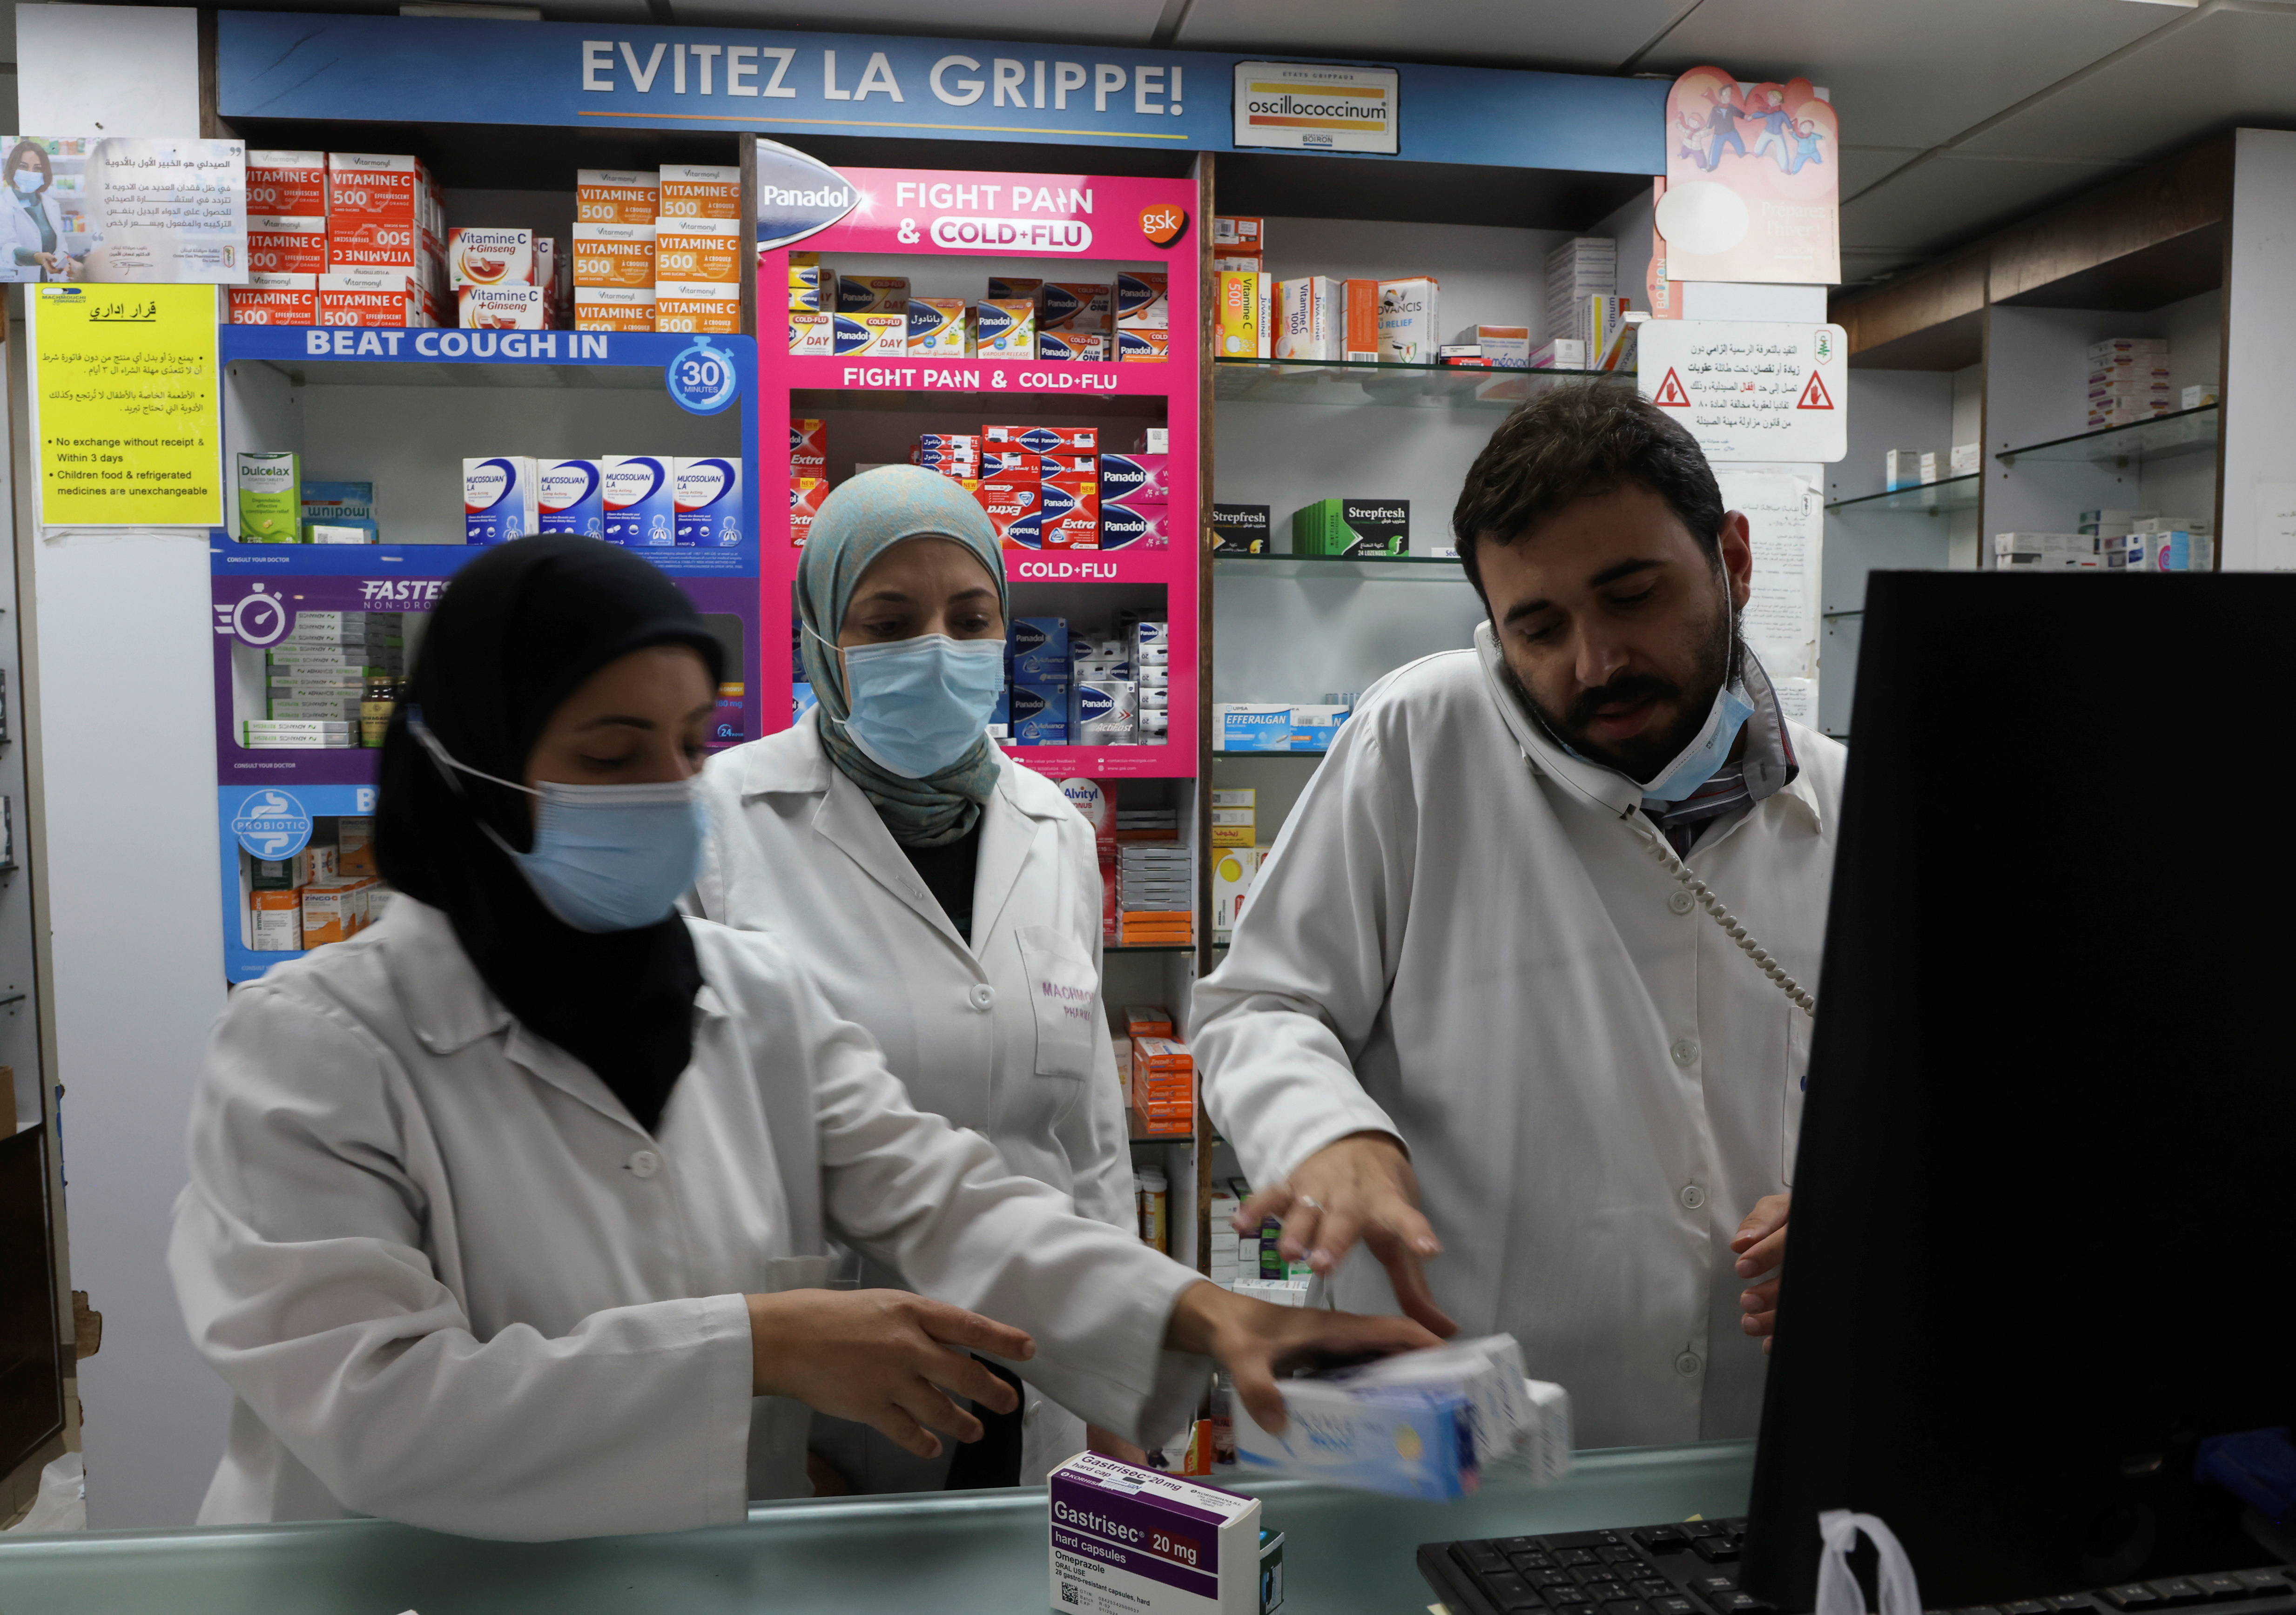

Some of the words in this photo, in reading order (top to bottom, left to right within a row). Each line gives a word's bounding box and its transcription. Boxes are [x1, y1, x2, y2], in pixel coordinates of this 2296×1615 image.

[581, 39, 797, 99] EVITEZ
[824, 50, 905, 104] LA
[929, 54, 1184, 117] GRIPPE!
[105, 158, 135, 168] بالأدوية
[140, 157, 155, 168] الأول
[158, 160, 181, 168] الخبير
[197, 161, 230, 170] الصيدلي
[353, 158, 390, 167] Vitarmonyl
[333, 174, 397, 186] VITAMINE
[401, 176, 410, 186] C
[202, 184, 215, 193] ظل
[333, 191, 366, 205] 500
[763, 185, 848, 208] Panadol
[896, 182, 1001, 211] FIGHT
[1012, 186, 1092, 214] PAIN
[203, 209, 231, 217] للحصول
[1762, 202, 1825, 220] Préparez
[679, 222, 716, 231] Vitarmonyl
[1143, 210, 1178, 234] gsk
[896, 217, 920, 245] &
[938, 220, 1083, 247] COLD+FLU
[1818, 223, 1820, 236] !
[458, 232, 515, 245] Vitamine
[518, 234, 526, 244] C
[660, 238, 724, 249] VITAMINE
[727, 240, 736, 250] C
[469, 244, 516, 255] +Ginseng
[660, 255, 693, 269] 500
[1228, 284, 1241, 306] 500
[1243, 279, 1252, 320] Vitamine
[90, 303, 124, 319] إداري
[130, 301, 156, 318] قرار
[910, 314, 940, 326] بانادول
[979, 316, 1010, 326] Panadol
[837, 331, 868, 341] Panadol
[306, 331, 411, 356] BEAT
[415, 333, 557, 359] COUGH
[568, 336, 607, 358] IN
[880, 339, 902, 348] DAY
[1730, 344, 1754, 355] الرسمية
[1041, 348, 1070, 357] Panadol
[1706, 344, 1727, 356] إلزامي
[682, 361, 719, 388] 30
[1688, 363, 1712, 374] عقوبات
[1784, 364, 1800, 376] زيادة
[843, 367, 917, 388] FIGHT
[924, 369, 980, 390] PAIN
[991, 370, 1007, 389] &
[1018, 372, 1118, 390] COLD+FLU
[684, 385, 719, 394] MINUTES
[143, 404, 163, 414] تحتاج
[74, 438, 120, 447] exchange
[162, 438, 193, 447] receipt
[101, 454, 123, 463] days
[791, 454, 824, 465] Extra
[136, 471, 191, 480] refrigerated
[242, 466, 290, 476] Dulcolax
[1104, 471, 1144, 482] Panadol
[58, 487, 106, 495] medicines
[130, 487, 208, 497] unexchangeable
[1044, 499, 1073, 507] Panadol
[308, 506, 370, 519] Imodium
[1349, 506, 1405, 520] Strepfresh
[1061, 518, 1096, 529] Extra
[1019, 562, 1117, 579] COLD+FLU
[1082, 700, 1113, 708] Panadol
[1225, 714, 1286, 724] EFFERALGAN
[1095, 723, 1133, 733] ActiFast
[1064, 787, 1098, 801] Alvityl
[237, 821, 305, 830] PROBIOTIC
[1165, 1481, 1183, 1491] mg
[1197, 1491, 1233, 1505] KORHISPANA
[1055, 1531, 1078, 1548] hard
[1081, 1541, 1126, 1564] capsules
[1153, 1534, 1170, 1552] 20
[1174, 1542, 1197, 1565] mg
[1056, 1551, 1105, 1574] Omeprazole
[1056, 1561, 1072, 1572] ORAL
[1074, 1568, 1085, 1576] USE
[1064, 1573, 1107, 1591] gastro-resistant
[1109, 1588, 1136, 1602] capsules,
[1137, 1597, 1150, 1606] hard
